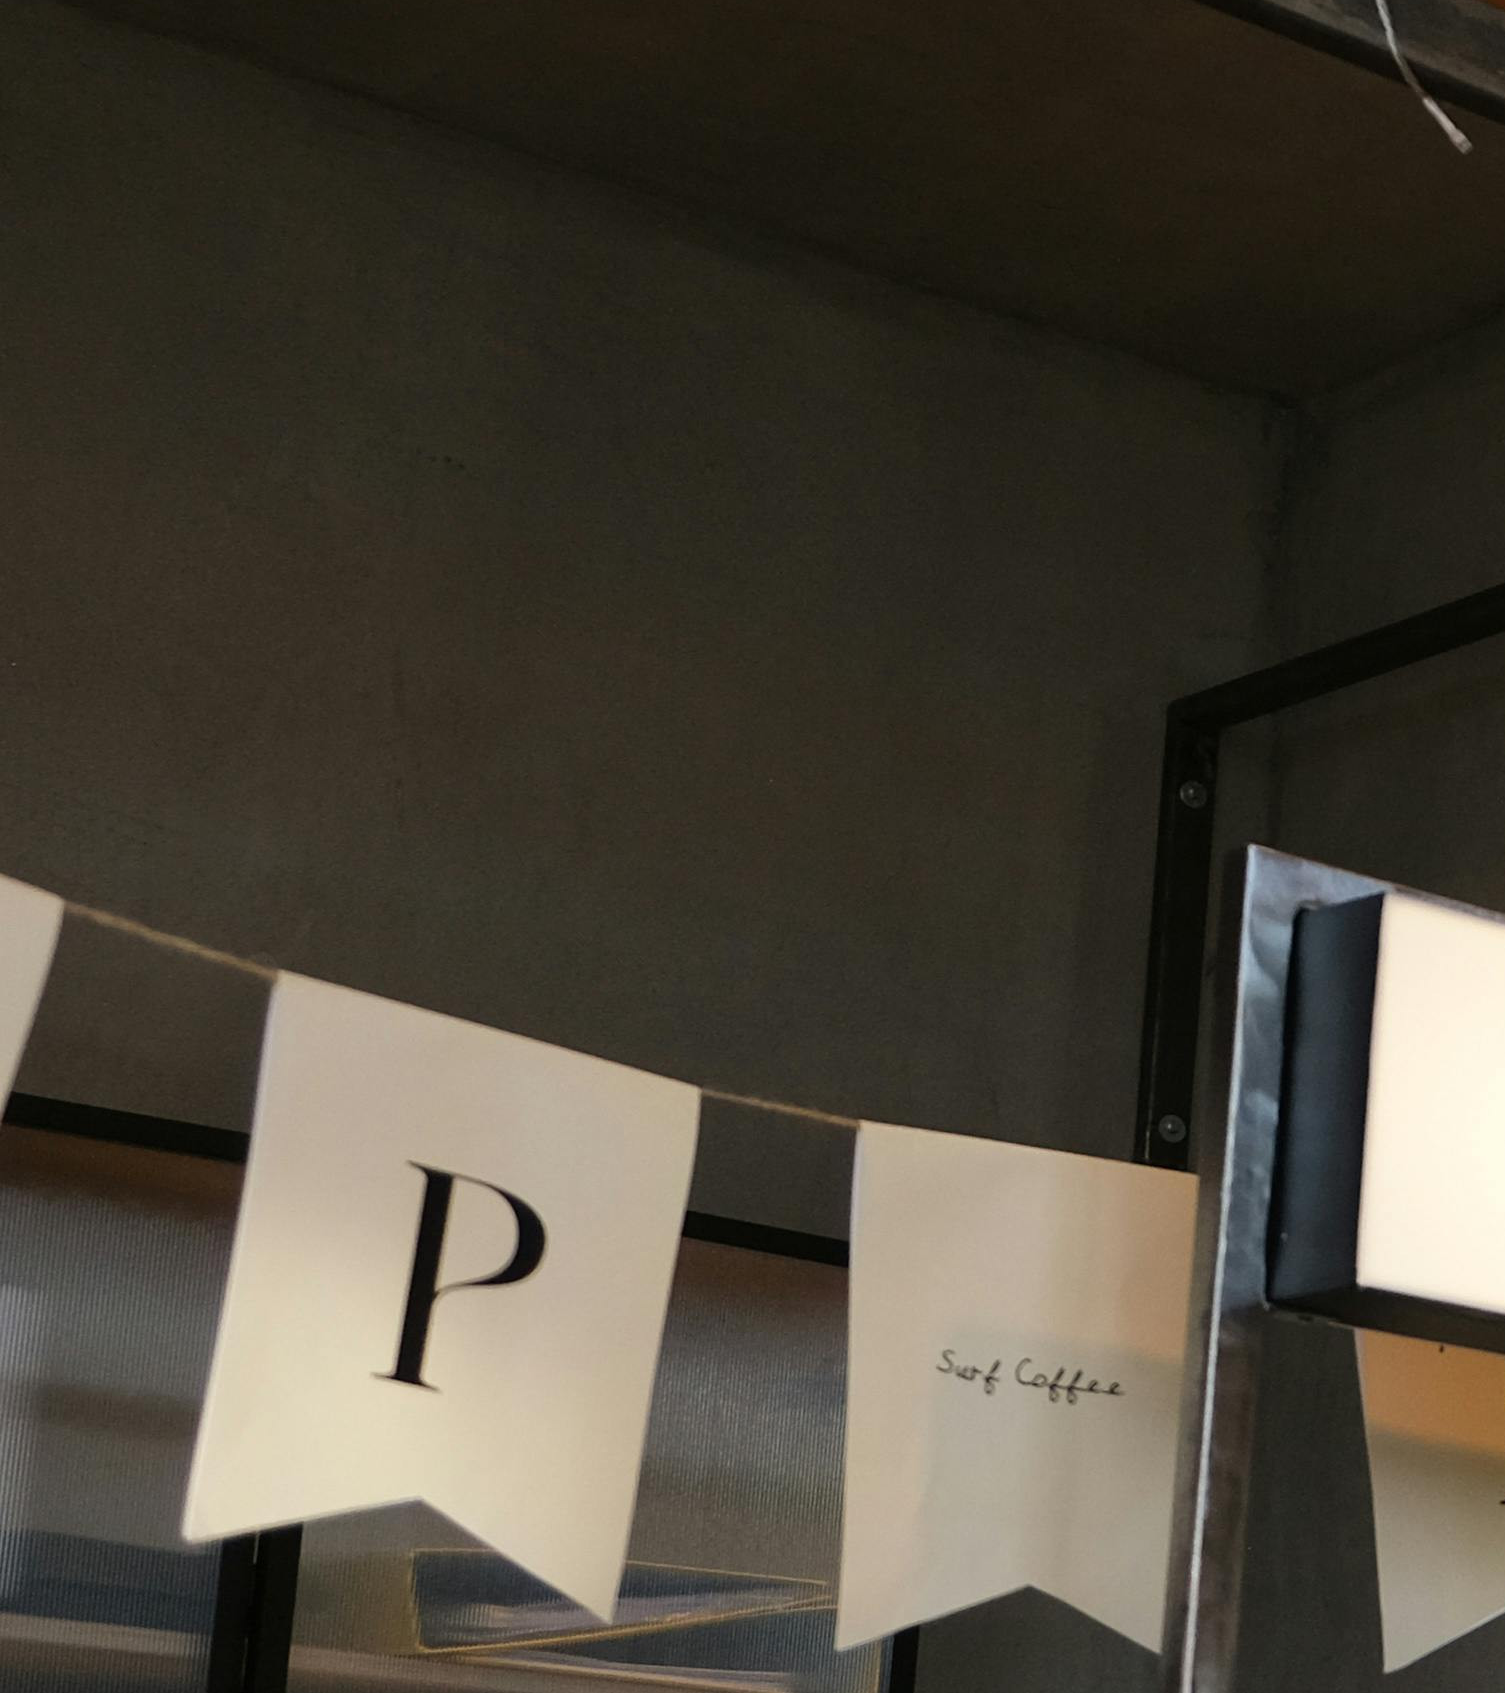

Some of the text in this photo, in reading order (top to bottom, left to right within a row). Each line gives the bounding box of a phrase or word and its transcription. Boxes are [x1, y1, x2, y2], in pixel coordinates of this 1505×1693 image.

[371, 1160, 547, 1393] P
[936, 1349, 1125, 1405] Surf Coffee
